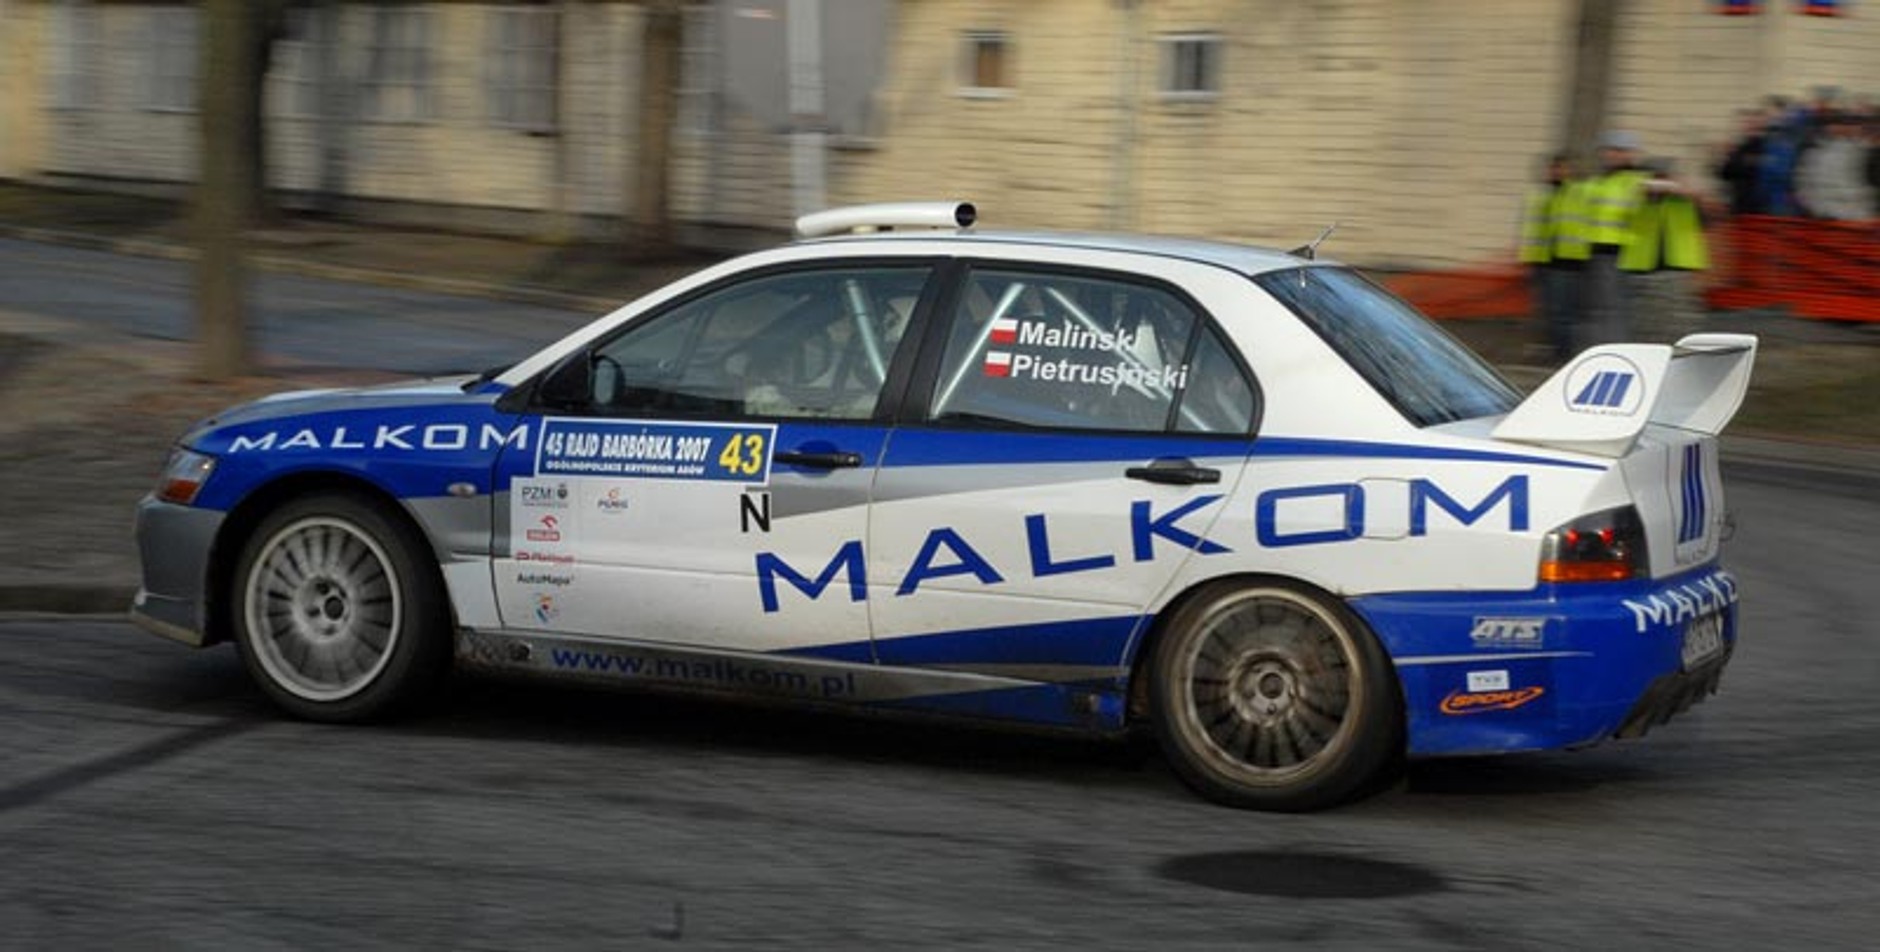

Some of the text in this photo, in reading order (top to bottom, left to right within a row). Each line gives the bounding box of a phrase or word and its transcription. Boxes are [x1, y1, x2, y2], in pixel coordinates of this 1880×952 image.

[228, 423, 529, 452] MALKOM
[545, 428, 712, 462] 45 RAJD BARBÓRKA 2007
[719, 432, 764, 475] 43
[740, 493, 770, 532] N
[755, 474, 1529, 613] MALKOM
[1470, 618, 1543, 640] ATS
[550, 646, 855, 697] www.malkom.pl
